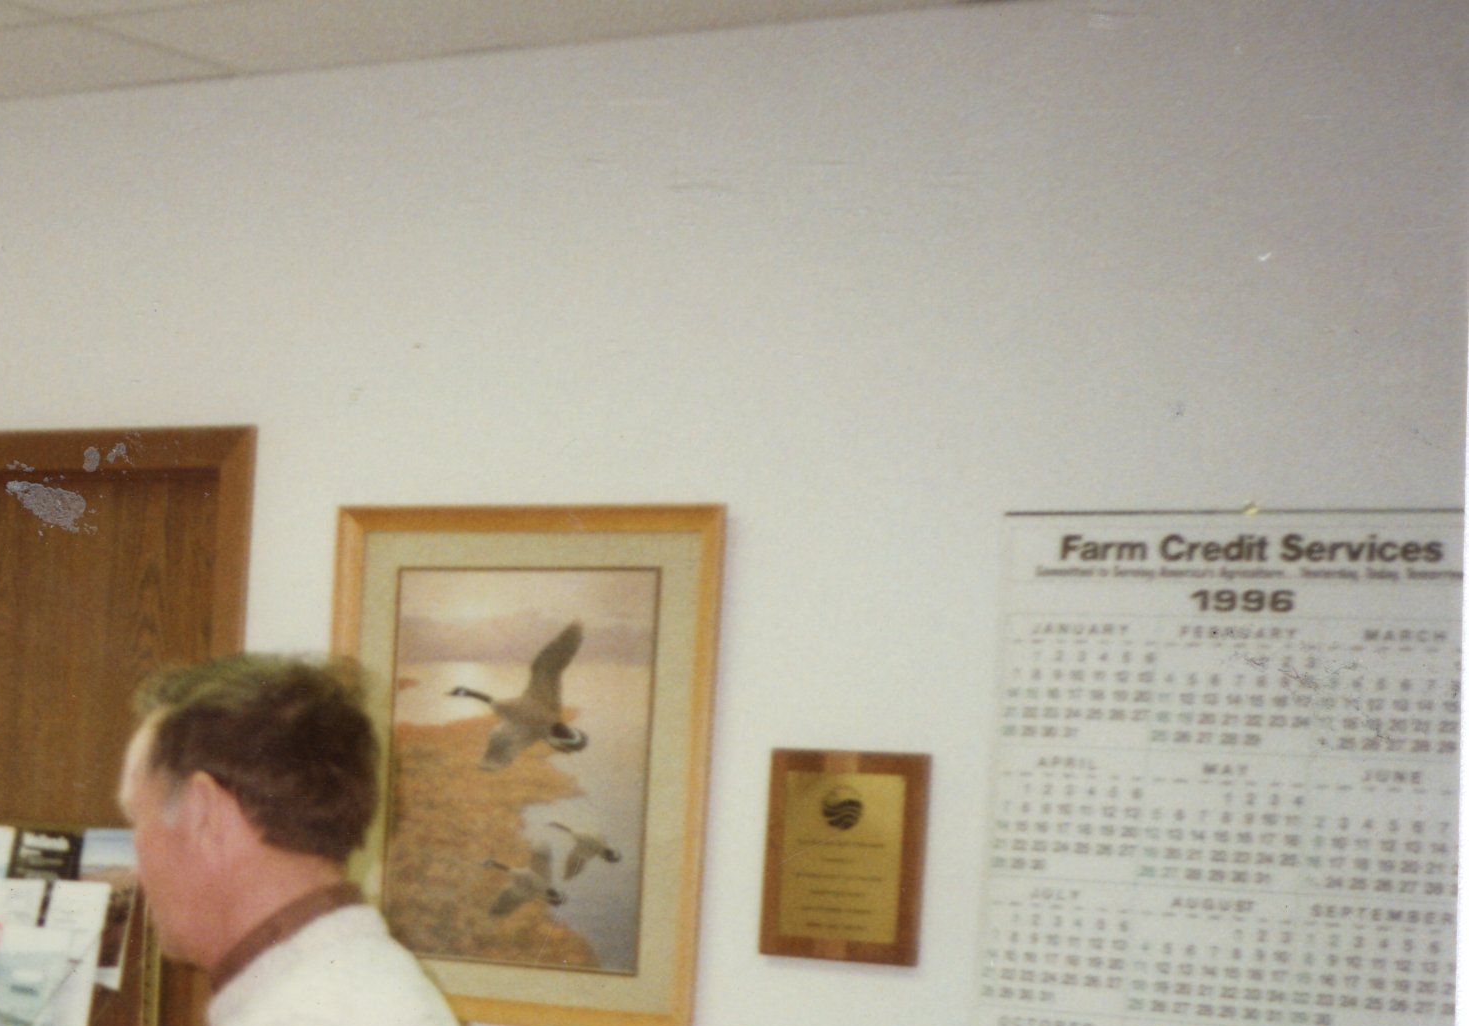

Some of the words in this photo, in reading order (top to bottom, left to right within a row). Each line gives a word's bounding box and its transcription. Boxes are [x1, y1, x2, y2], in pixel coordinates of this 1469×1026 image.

[1059, 534, 1148, 562] Farm
[1160, 533, 1270, 563] Credit
[1279, 533, 1445, 563] Services
[1189, 589, 1296, 613] 1996
